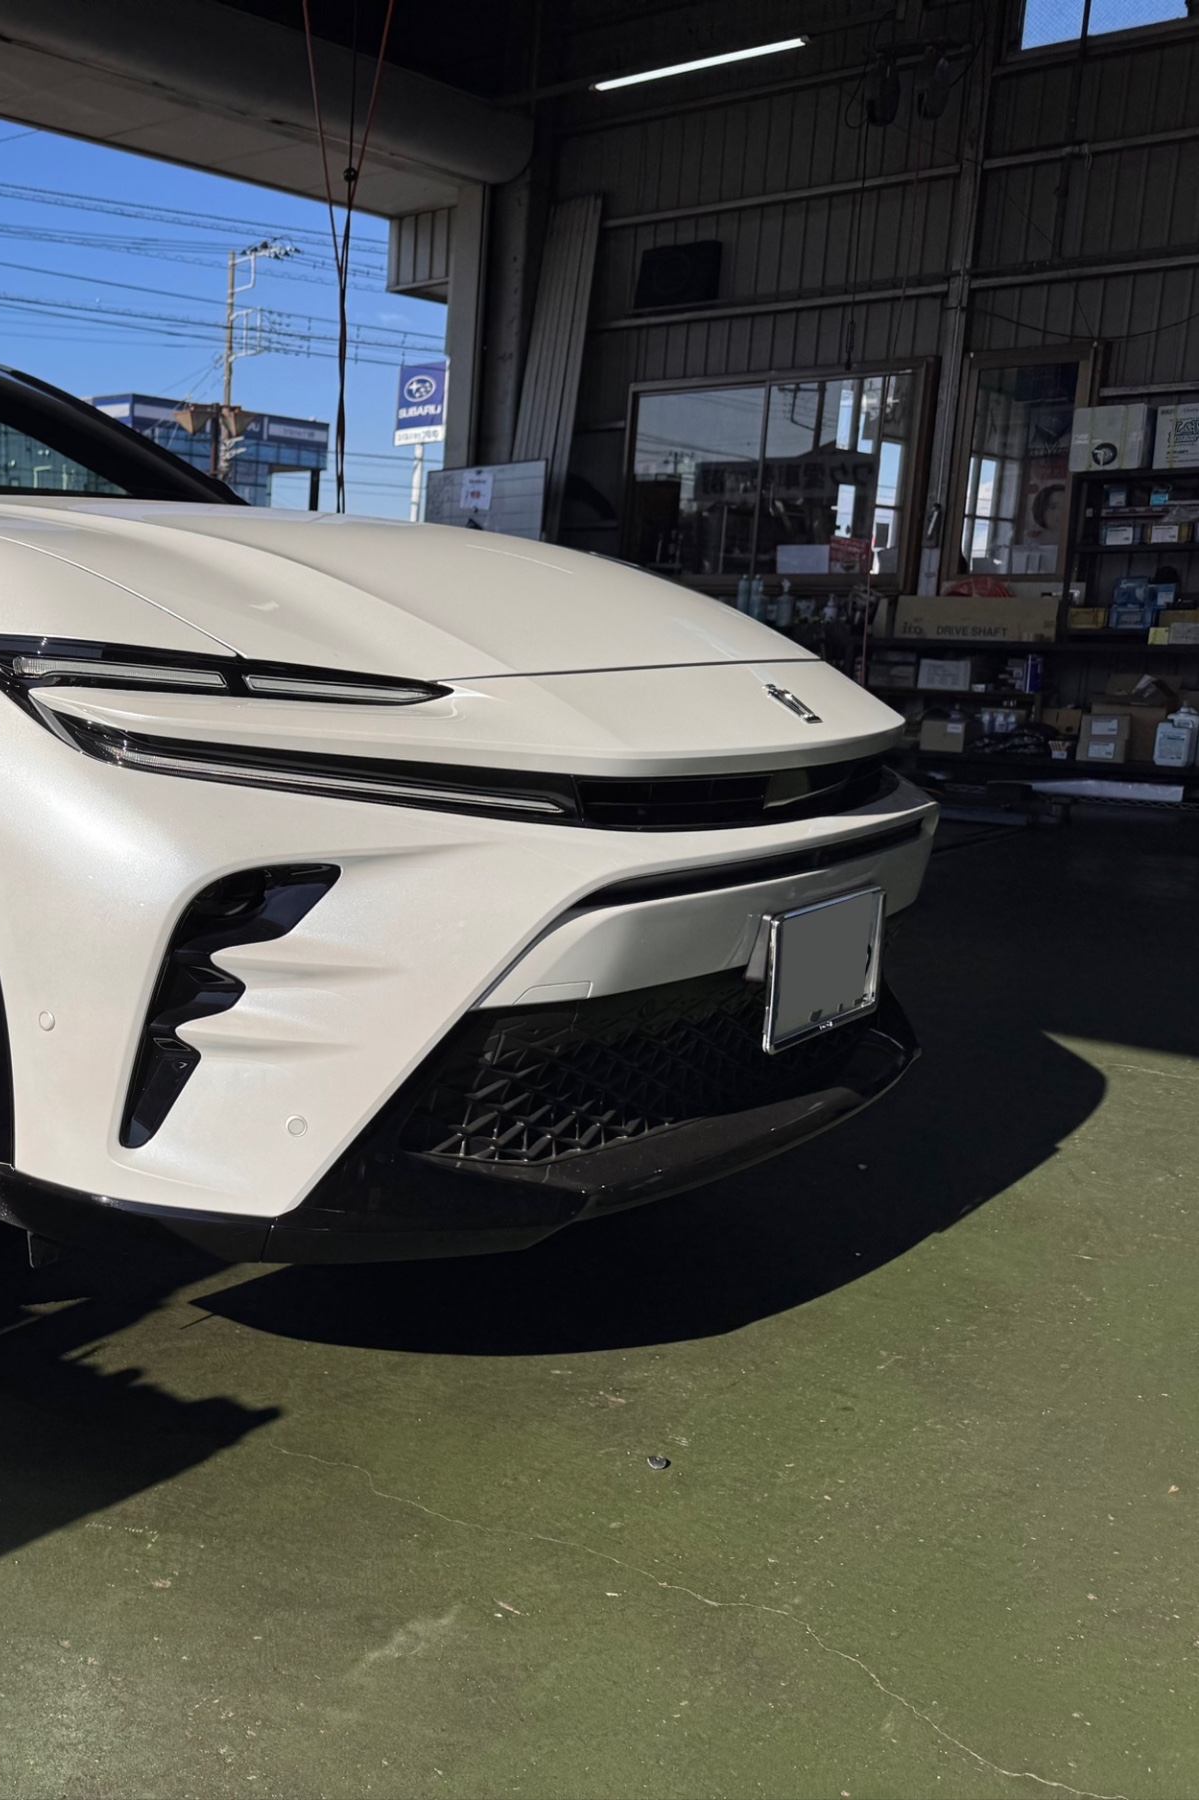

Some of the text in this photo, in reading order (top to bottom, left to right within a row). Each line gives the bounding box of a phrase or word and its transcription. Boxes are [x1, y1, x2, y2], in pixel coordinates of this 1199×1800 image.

[398, 404, 442, 419] SUBARU
[936, 625, 969, 637] DRIVE
[971, 626, 1008, 638] SHAFT
